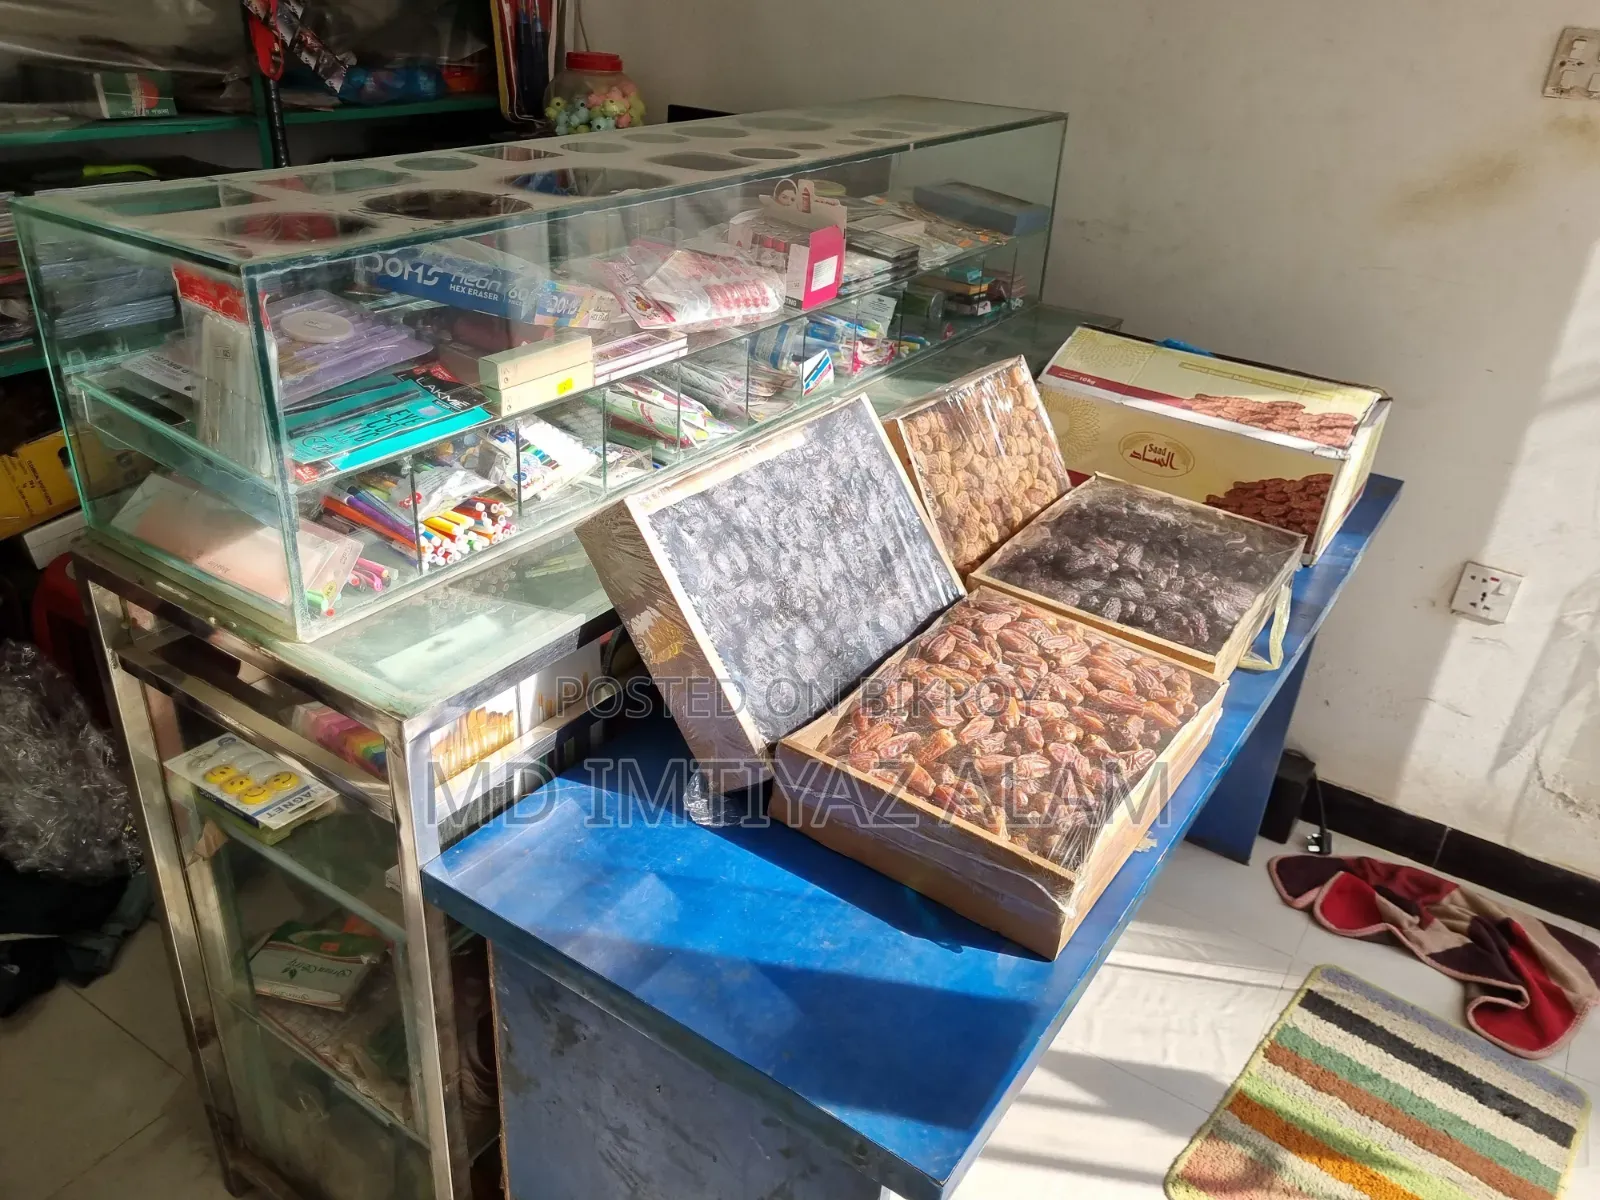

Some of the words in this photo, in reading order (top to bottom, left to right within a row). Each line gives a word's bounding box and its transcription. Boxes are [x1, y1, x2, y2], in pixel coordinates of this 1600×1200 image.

[364, 253, 444, 286] DOMS
[449, 283, 466, 294] HEX
[467, 287, 499, 301] ERASER
[508, 284, 530, 300] 60
[1148, 443, 1167, 456] Saad
[265, 785, 326, 819] MAGNET
